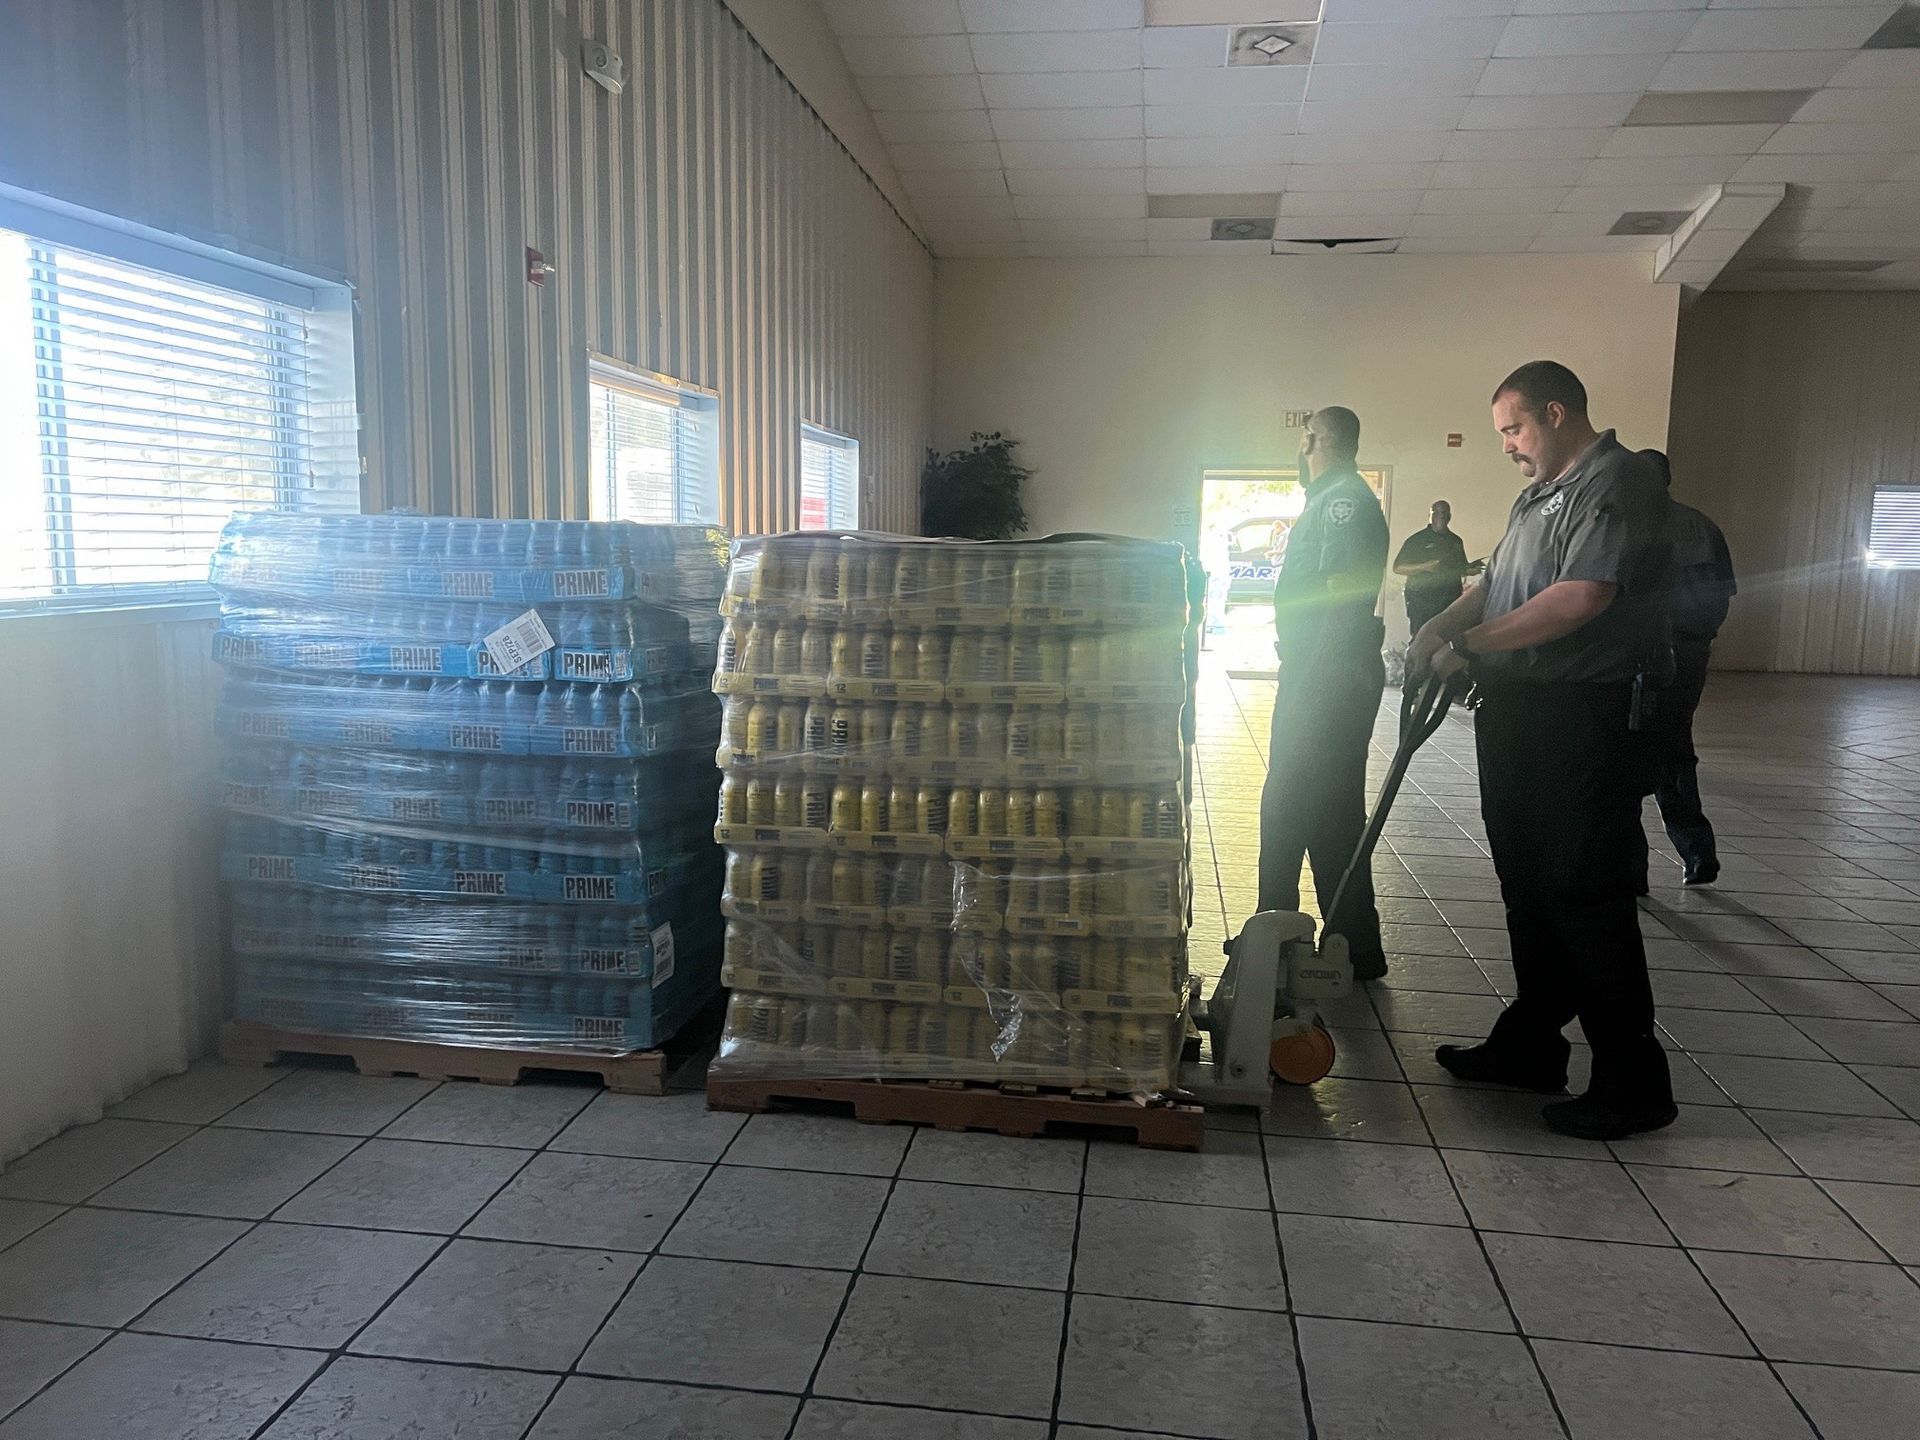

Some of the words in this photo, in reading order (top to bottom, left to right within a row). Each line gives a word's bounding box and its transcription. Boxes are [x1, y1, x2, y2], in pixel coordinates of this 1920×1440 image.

[1286, 411, 1308, 428] EXI
[555, 571, 607, 596] PRIME
[1229, 566, 1275, 579] MAR
[442, 572, 493, 596] PRIME
[222, 636, 265, 660] PRIME
[392, 648, 441, 672] PRIME
[836, 684, 846, 693] 12
[241, 713, 288, 736] PRIME
[452, 725, 501, 749] PRIME
[565, 728, 616, 751] PRIME
[392, 798, 440, 820] PRIME
[485, 800, 535, 822] PRIME
[566, 802, 615, 825] PRIME
[249, 857, 295, 879] PRIME
[455, 872, 505, 894] PRIME
[565, 877, 615, 900] PRIME
[580, 950, 625, 972] PRIME
[574, 1018, 623, 1038] PRIME
